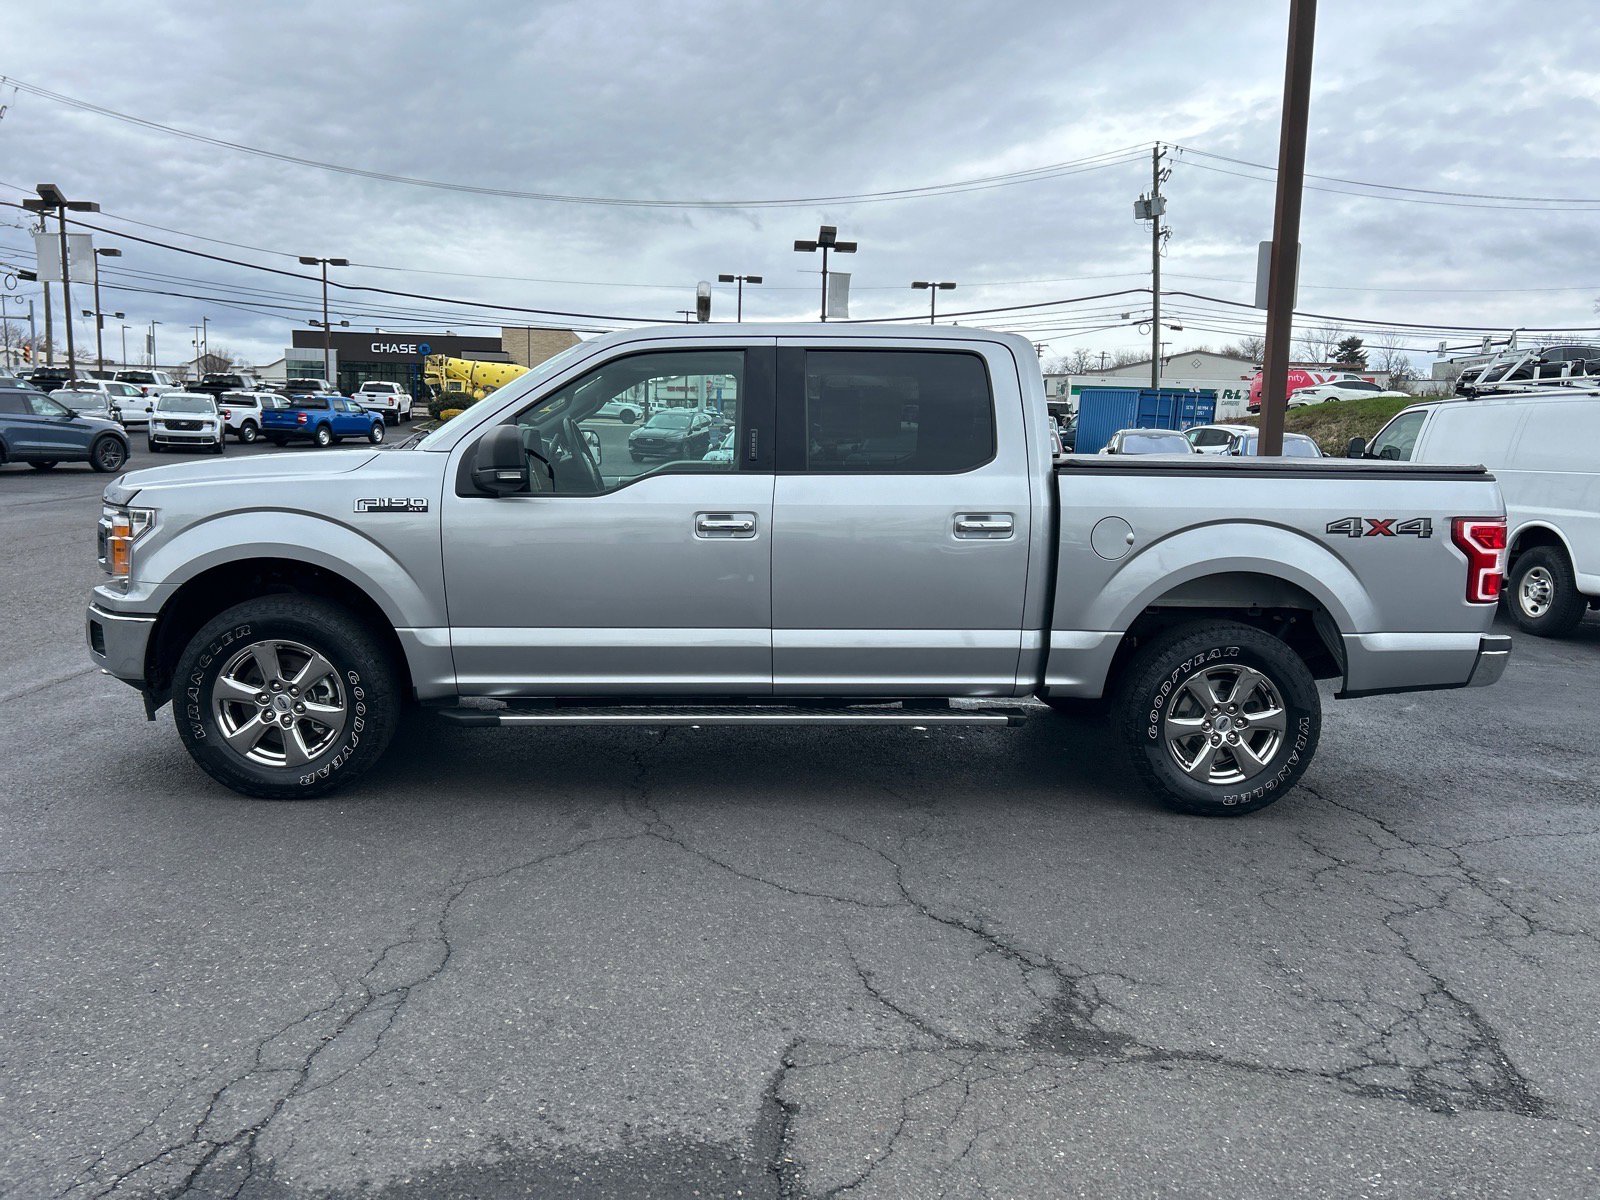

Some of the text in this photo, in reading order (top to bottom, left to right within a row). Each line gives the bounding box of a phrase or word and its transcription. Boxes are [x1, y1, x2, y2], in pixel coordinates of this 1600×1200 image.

[371, 343, 417, 354] CHASE
[1288, 374, 1305, 383] nity
[188, 625, 251, 739] WRANGLER
[1149, 647, 1240, 739] GOODYEAR
[300, 670, 366, 785] GOODYEAR
[1223, 717, 1310, 806] WRANGLER
